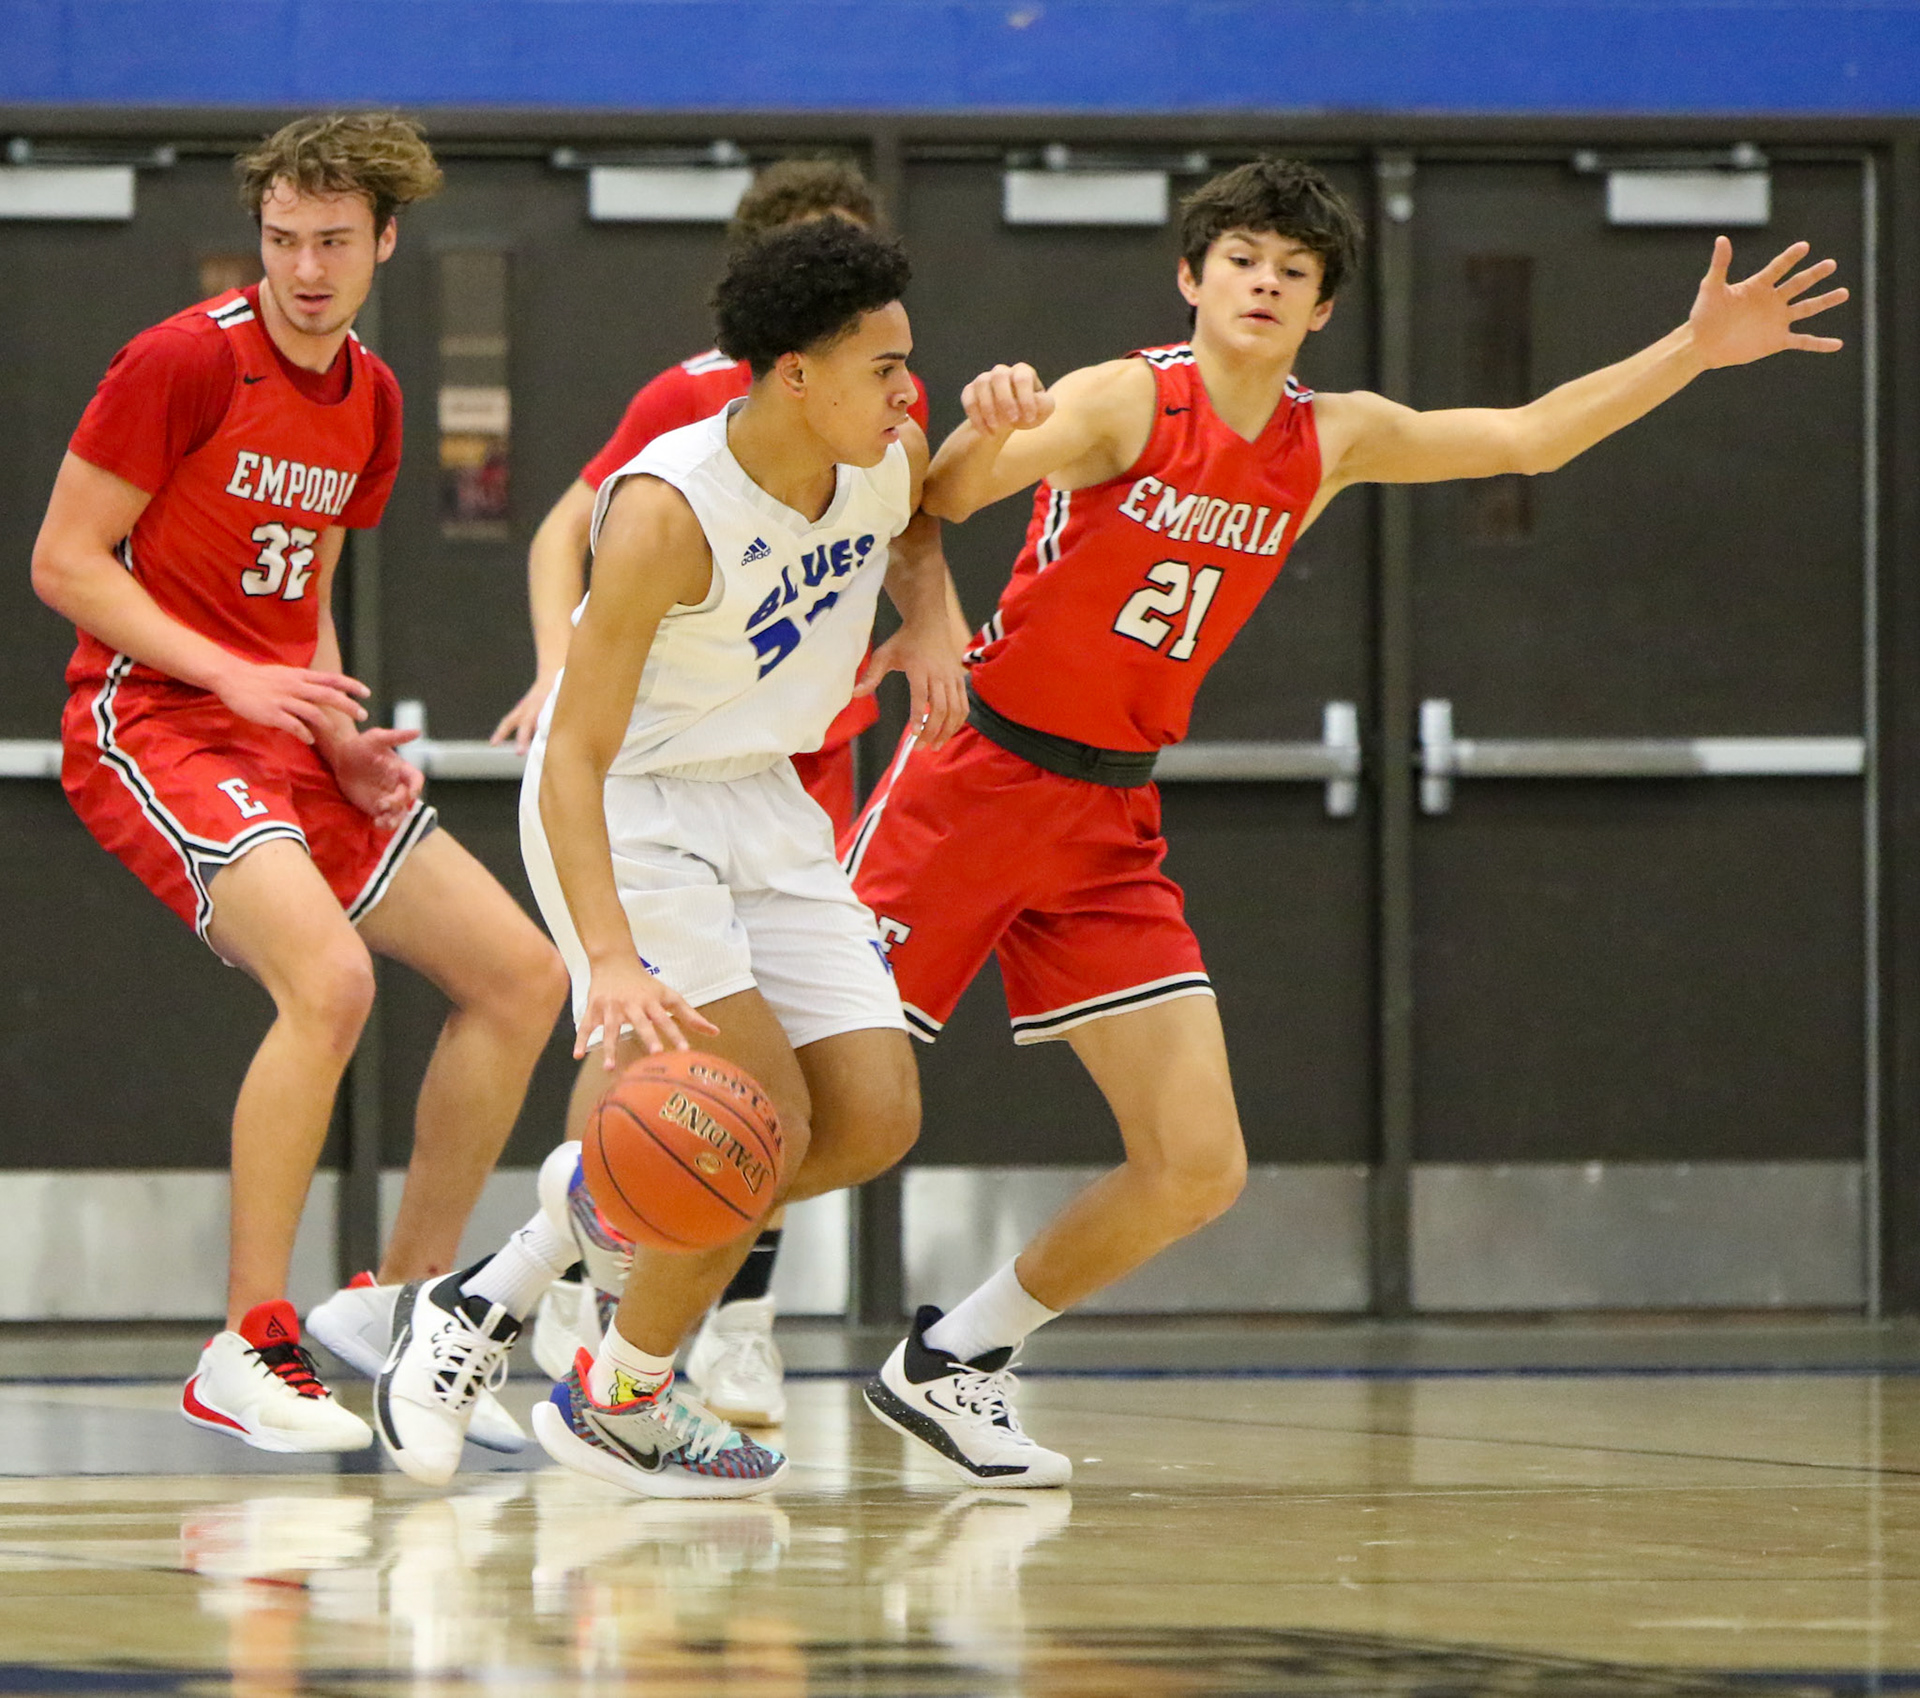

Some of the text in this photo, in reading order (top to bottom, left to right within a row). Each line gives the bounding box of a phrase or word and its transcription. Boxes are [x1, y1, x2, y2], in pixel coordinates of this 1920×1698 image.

[1117, 475, 1292, 556] EMPORIA
[744, 533, 876, 633] BLUES
[1111, 558, 1225, 661] 21
[216, 777, 270, 820] E
[659, 1091, 771, 1197] SPALDING
